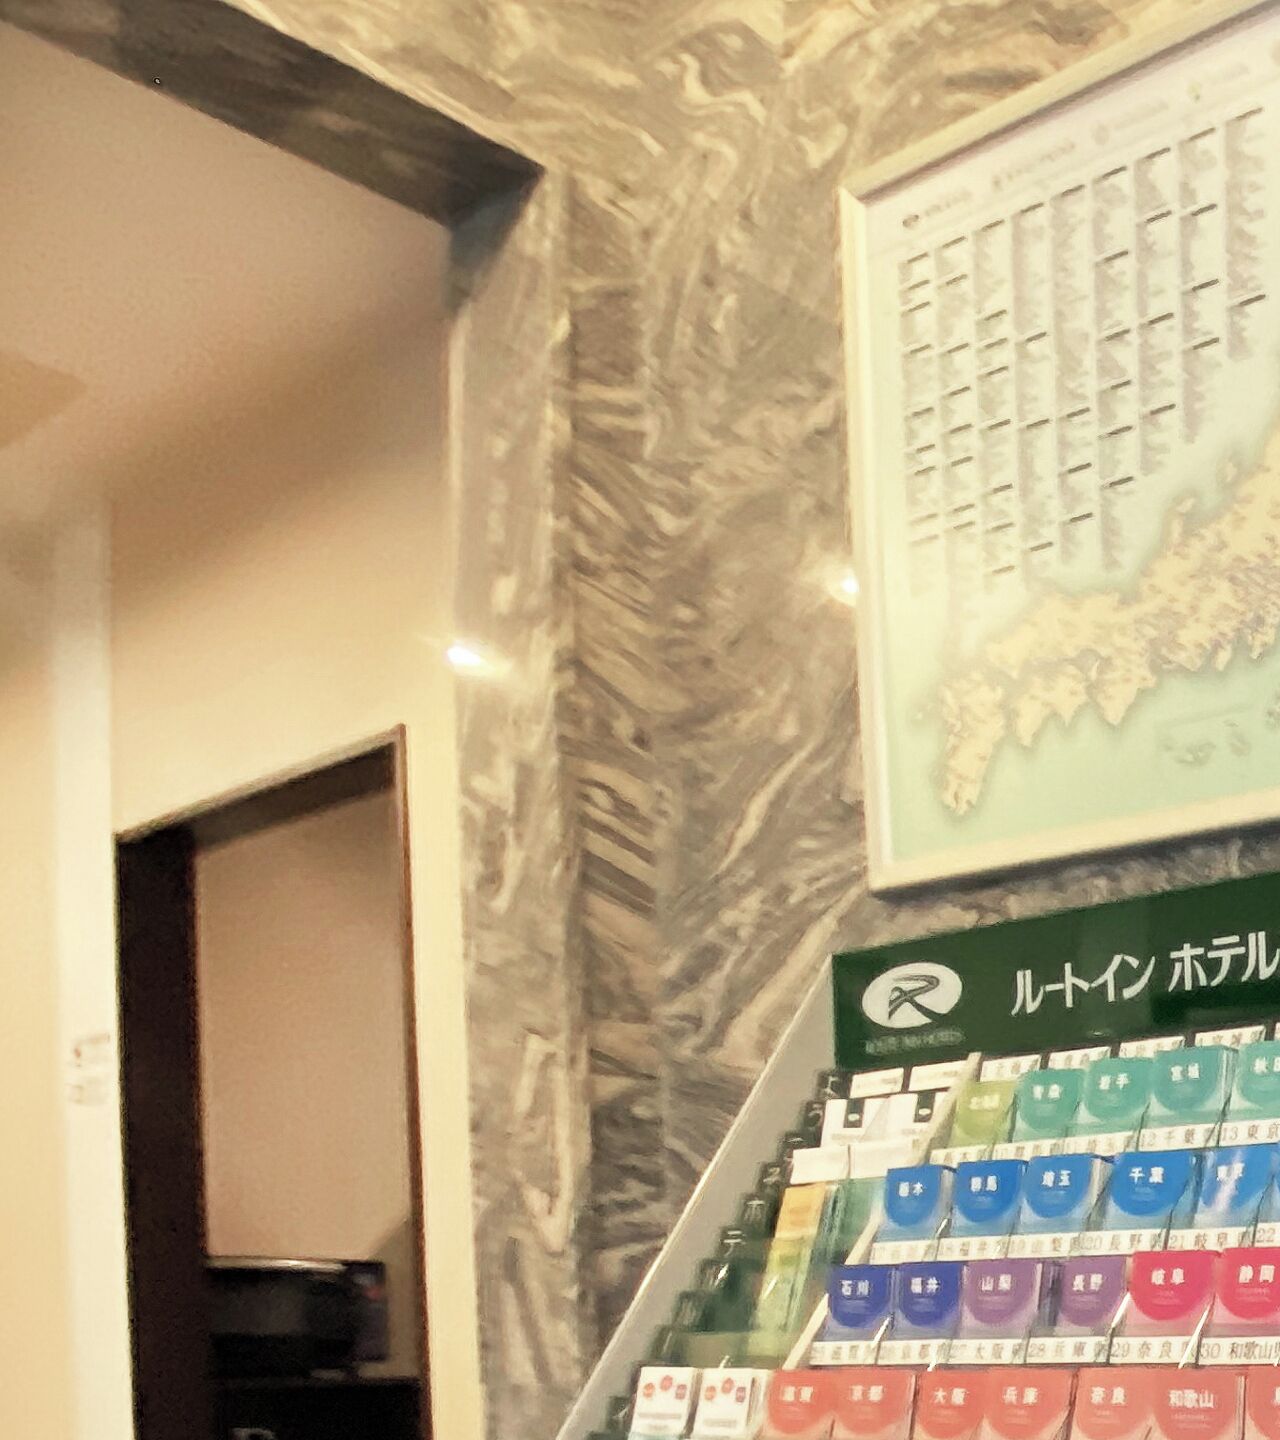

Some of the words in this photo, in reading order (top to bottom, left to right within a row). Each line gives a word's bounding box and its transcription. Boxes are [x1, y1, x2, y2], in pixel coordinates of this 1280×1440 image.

[1011, 954, 1154, 1017] ルートイン
[1130, 1166, 1165, 1185] 千葉
[1170, 1234, 1185, 1249] 21
[1256, 1227, 1276, 1243] 22
[1151, 1265, 1185, 1285] 岐阜
[1238, 1264, 1276, 1284] 静岡
[1110, 1342, 1130, 1358] 29
[1202, 1342, 1221, 1360] 30
[934, 1387, 969, 1406] 大阪
[1004, 1386, 1039, 1406] 兵庫
[1091, 1386, 1127, 1406] 奈良
[1169, 1389, 1215, 1409] 和歌山
